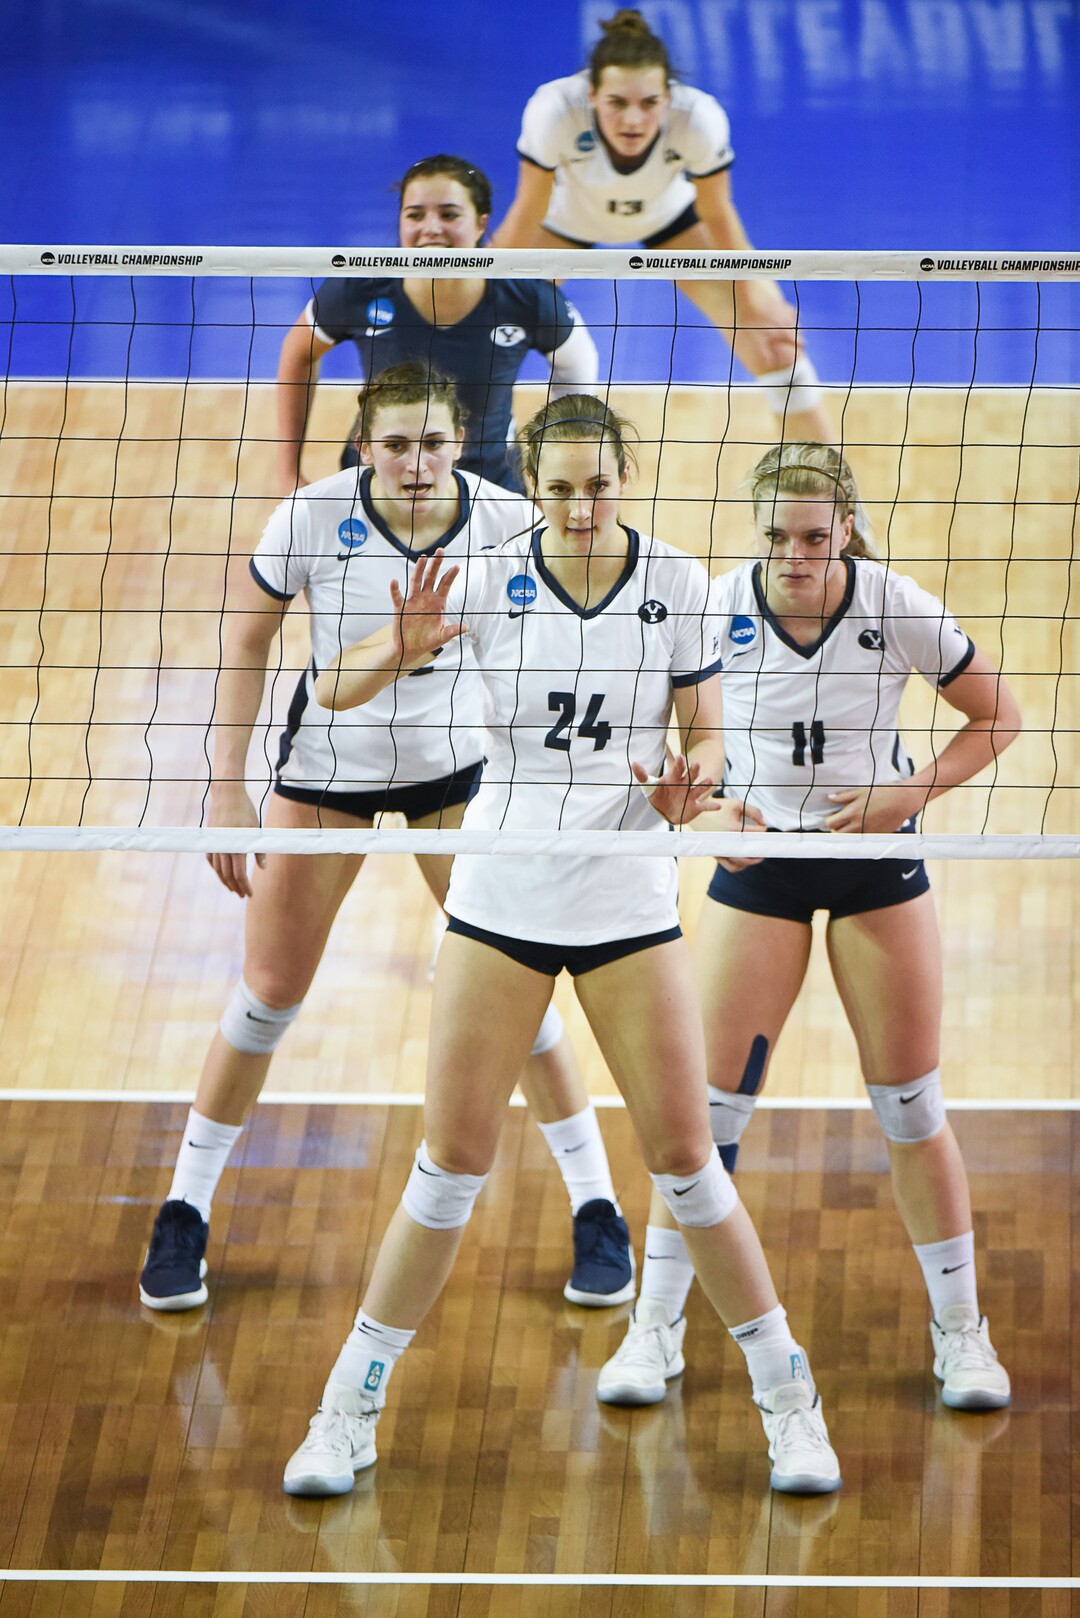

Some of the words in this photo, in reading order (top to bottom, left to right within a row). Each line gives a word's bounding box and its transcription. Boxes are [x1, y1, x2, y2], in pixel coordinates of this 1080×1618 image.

[607, 199, 644, 215] 13
[58, 254, 118, 264] VOLLEYBALL
[121, 255, 203, 265] CHAMPIONSHIP
[349, 256, 409, 267] VOLLEYBALL
[413, 257, 494, 267] CHAMPIONSHIP
[646, 258, 707, 268] VOLLEYBALL
[710, 259, 791, 269] CHAMPIONSHIP
[937, 260, 997, 270] VOLLEYBALL
[511, 588, 536, 598] NCAA
[731, 627, 755, 639] NCAA
[544, 691, 611, 752] 24
[792, 720, 825, 766] 11
